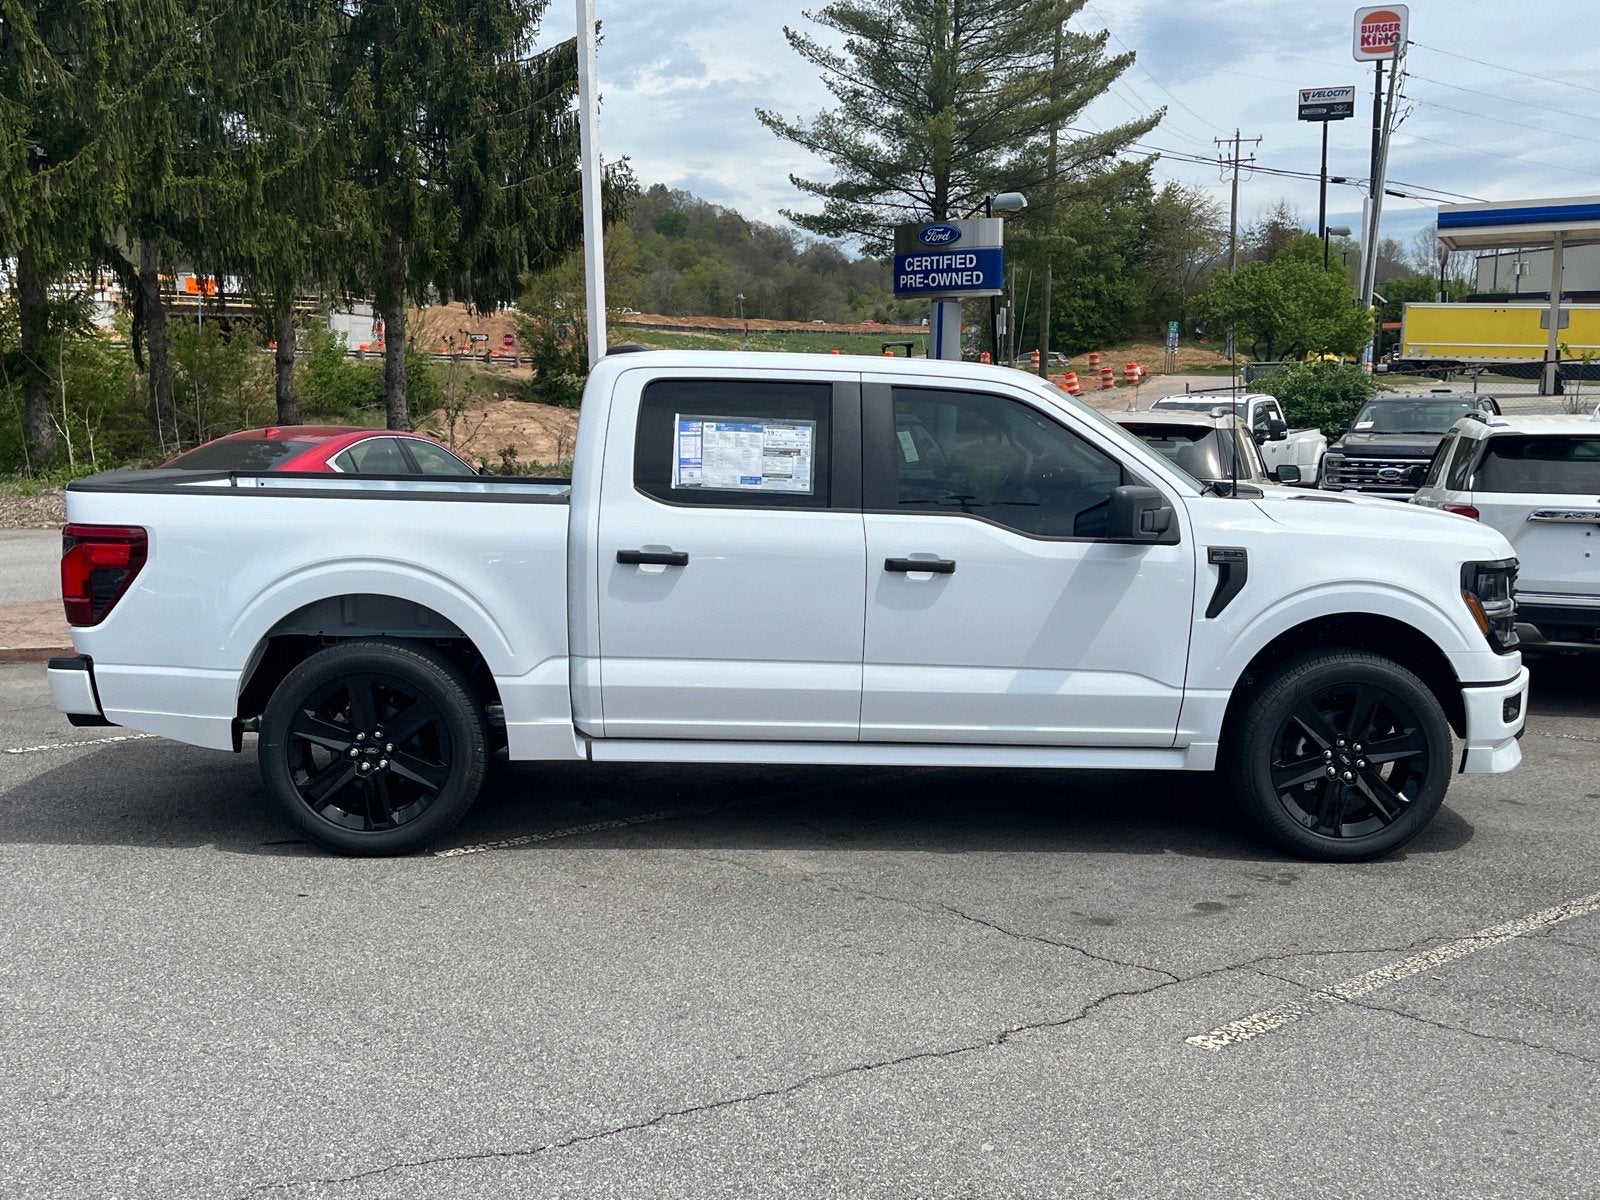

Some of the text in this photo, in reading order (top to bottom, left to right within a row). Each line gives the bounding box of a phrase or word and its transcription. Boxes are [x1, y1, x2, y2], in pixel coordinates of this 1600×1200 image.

[1361, 23, 1400, 34] BURGER
[1312, 90, 1351, 98] VELOCITY
[925, 228, 951, 242] Ford
[905, 254, 977, 271] CERTIFIED
[900, 271, 984, 288] PRE-OWNED
